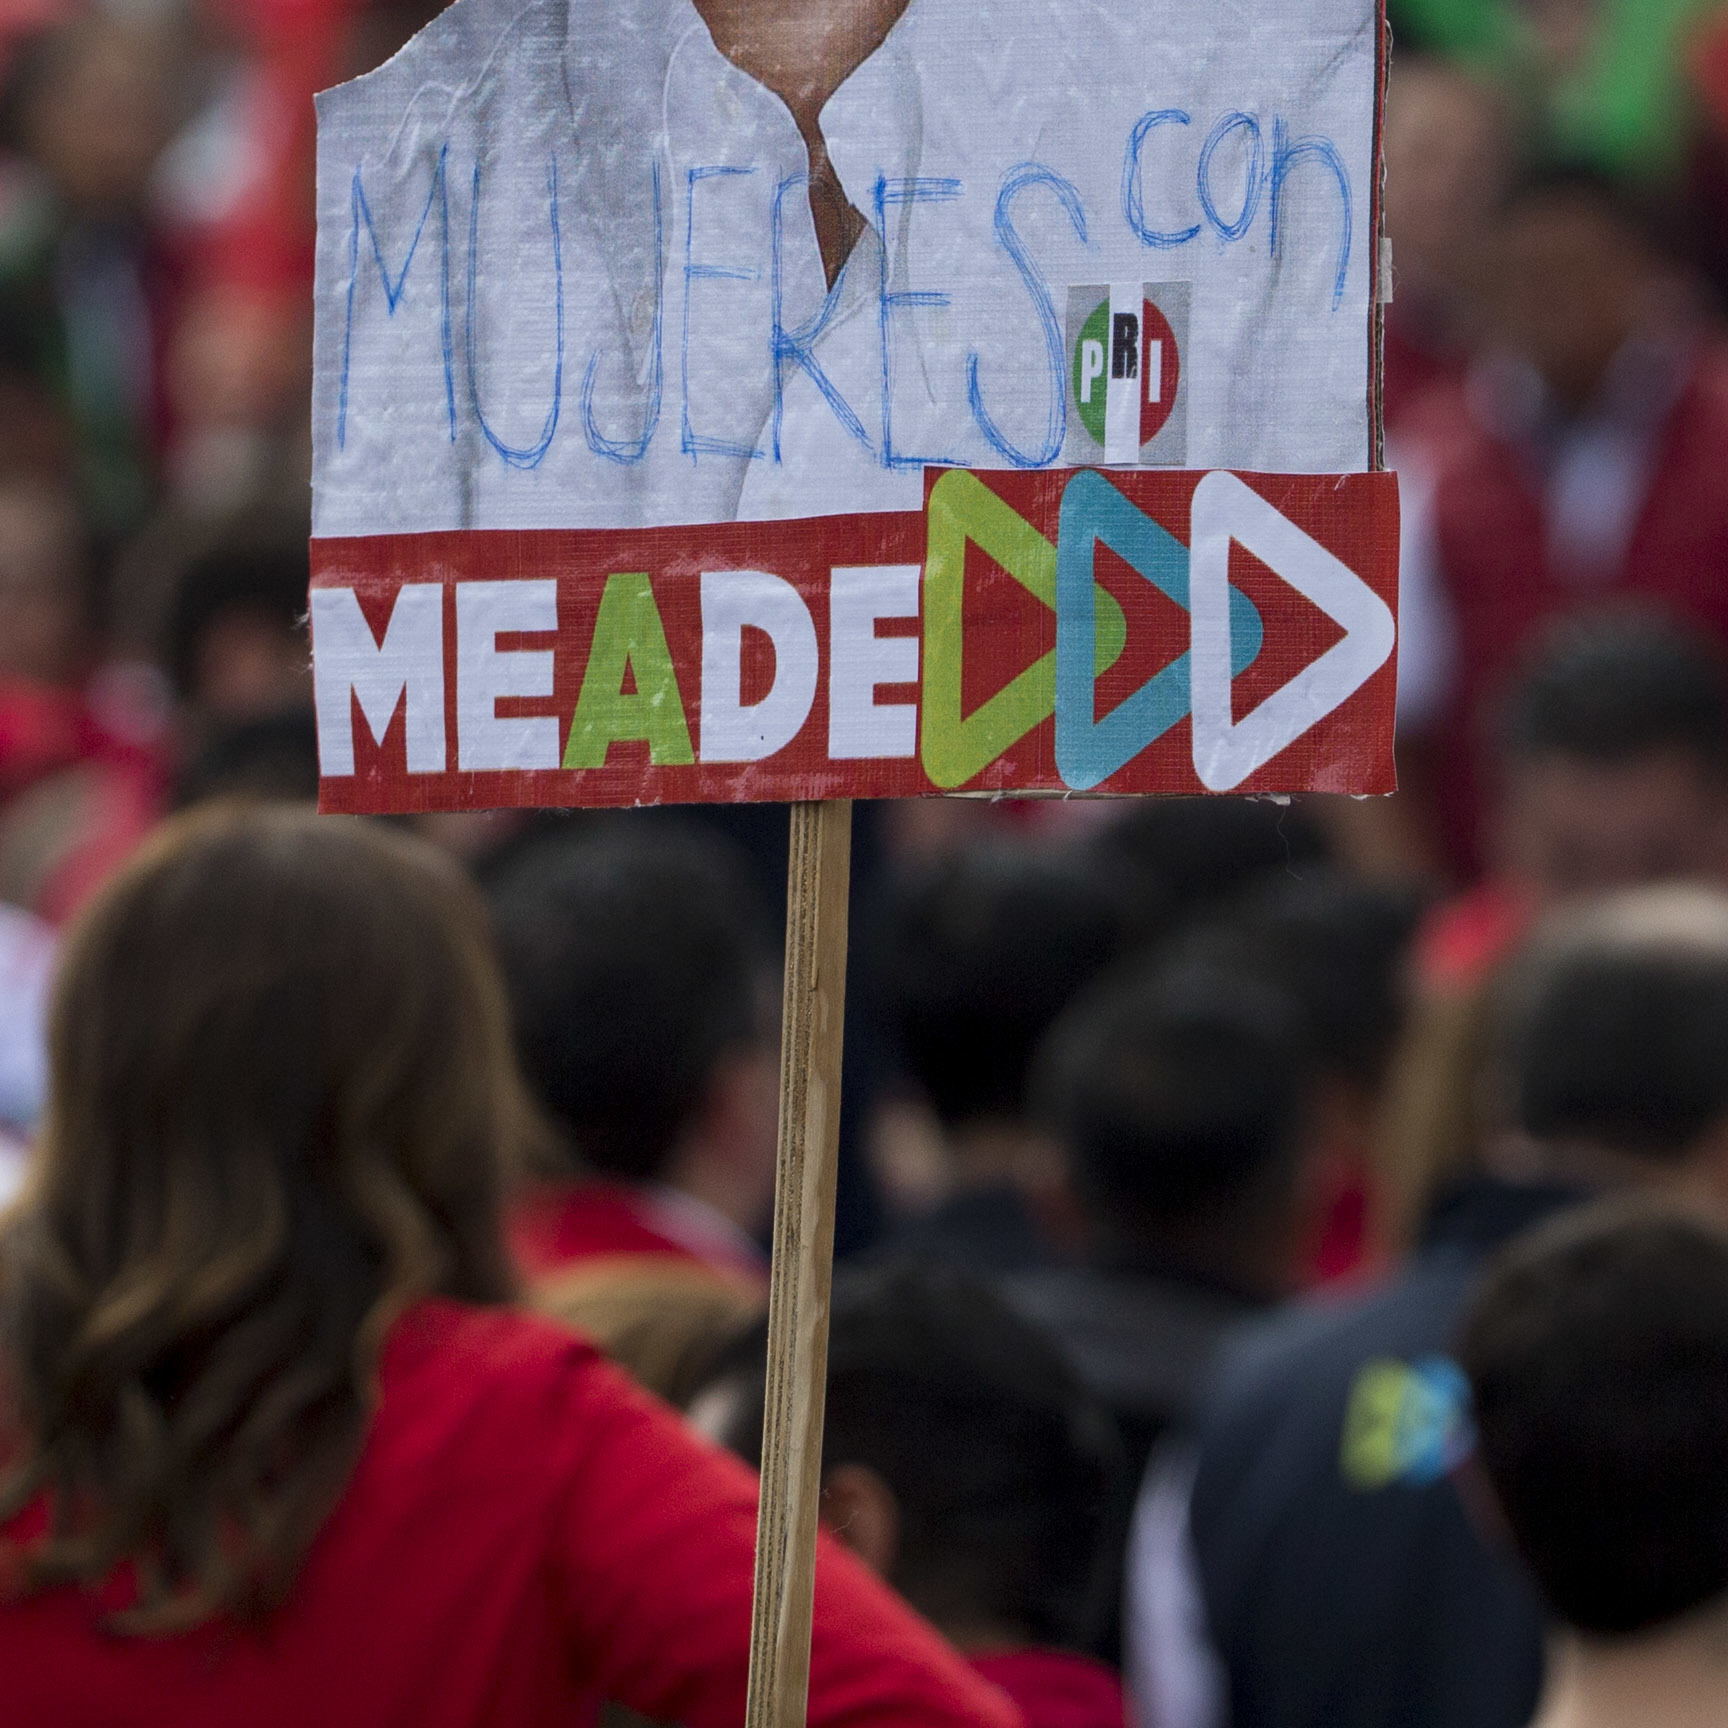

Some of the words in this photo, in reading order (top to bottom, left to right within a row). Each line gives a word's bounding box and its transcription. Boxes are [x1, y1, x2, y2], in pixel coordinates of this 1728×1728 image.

[338, 140, 1092, 469] MUJERES
[1122, 110, 1354, 312] con
[1080, 311, 1162, 405] PRI
[310, 564, 922, 777] MEADE
